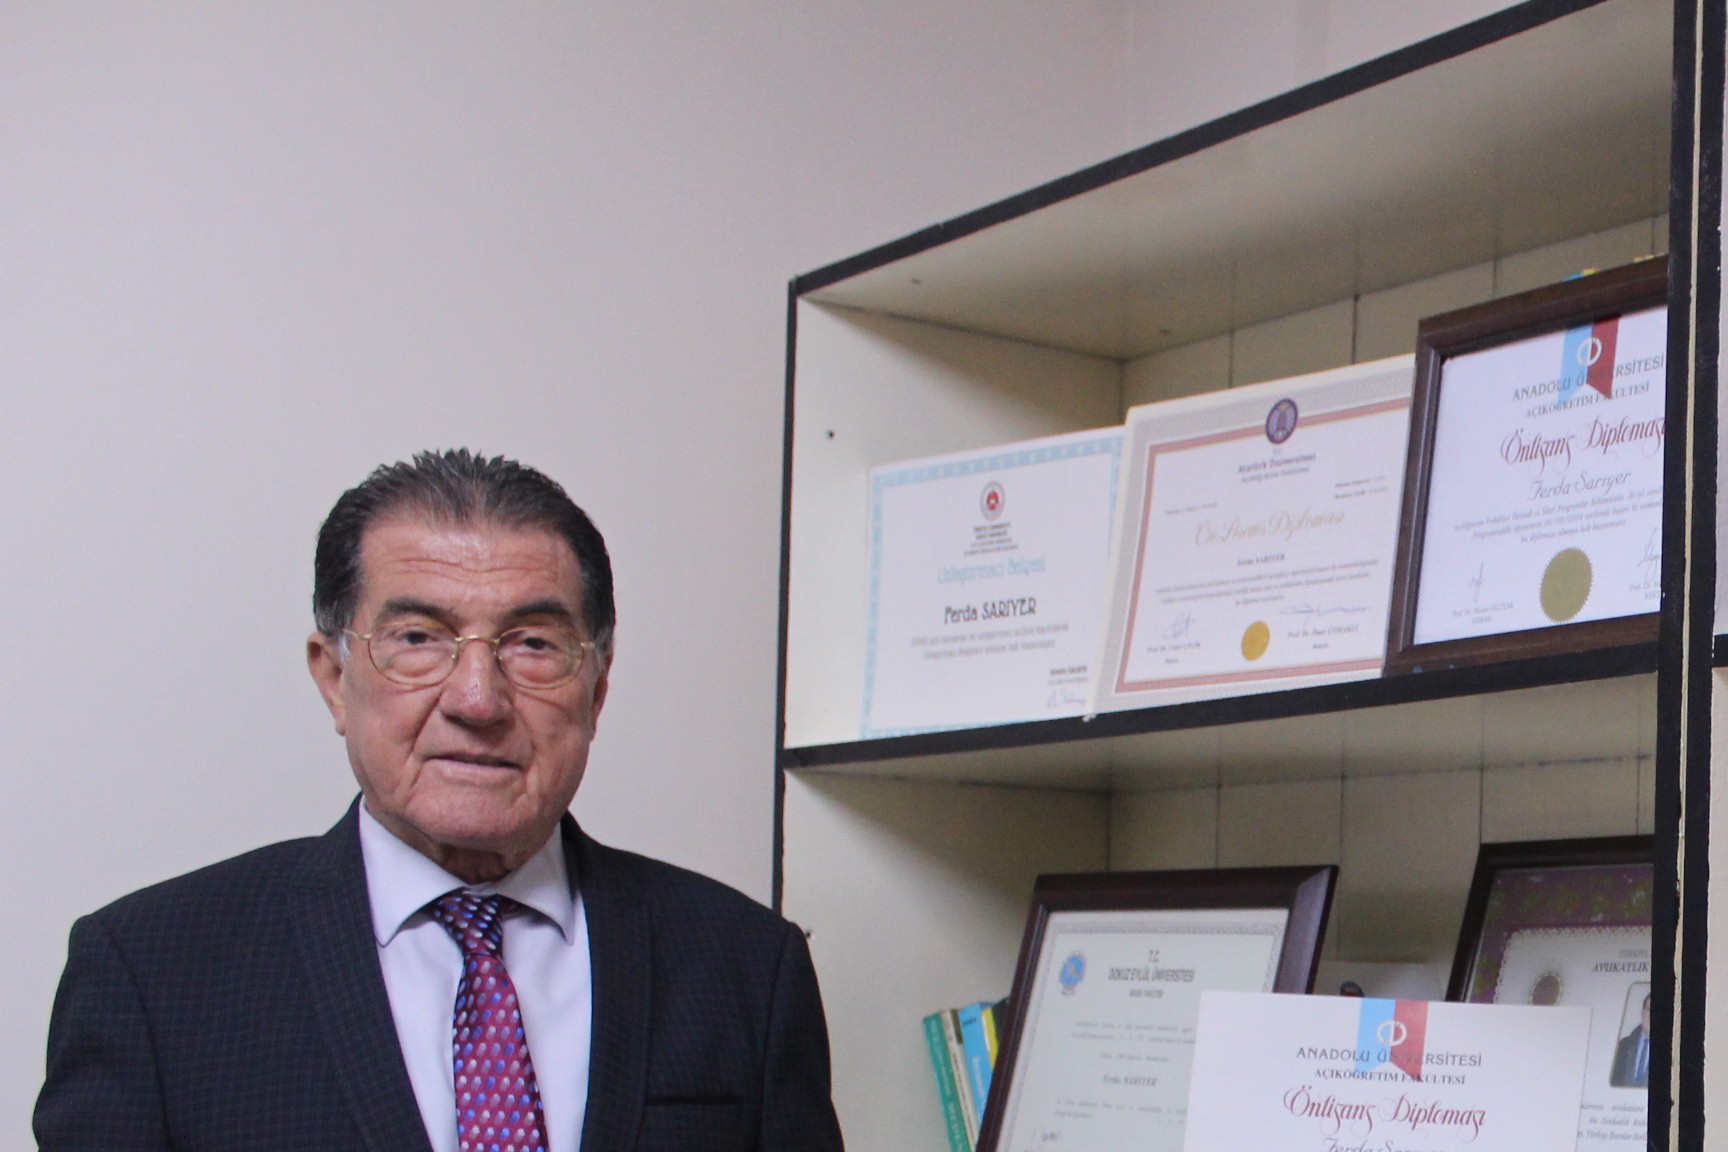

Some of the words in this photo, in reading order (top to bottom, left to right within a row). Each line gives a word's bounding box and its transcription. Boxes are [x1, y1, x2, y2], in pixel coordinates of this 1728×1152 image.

[1513, 376, 1571, 401] ANADOLU
[1528, 476, 1570, 500] Ferda
[1575, 472, 1632, 495] Sarıyer
[944, 605, 978, 624] Ferda
[982, 597, 1036, 620] SARIYER
[1297, 1048, 1370, 1061] ANADOLU
[1315, 1069, 1399, 1081] AÇIKÖĞRETİM
